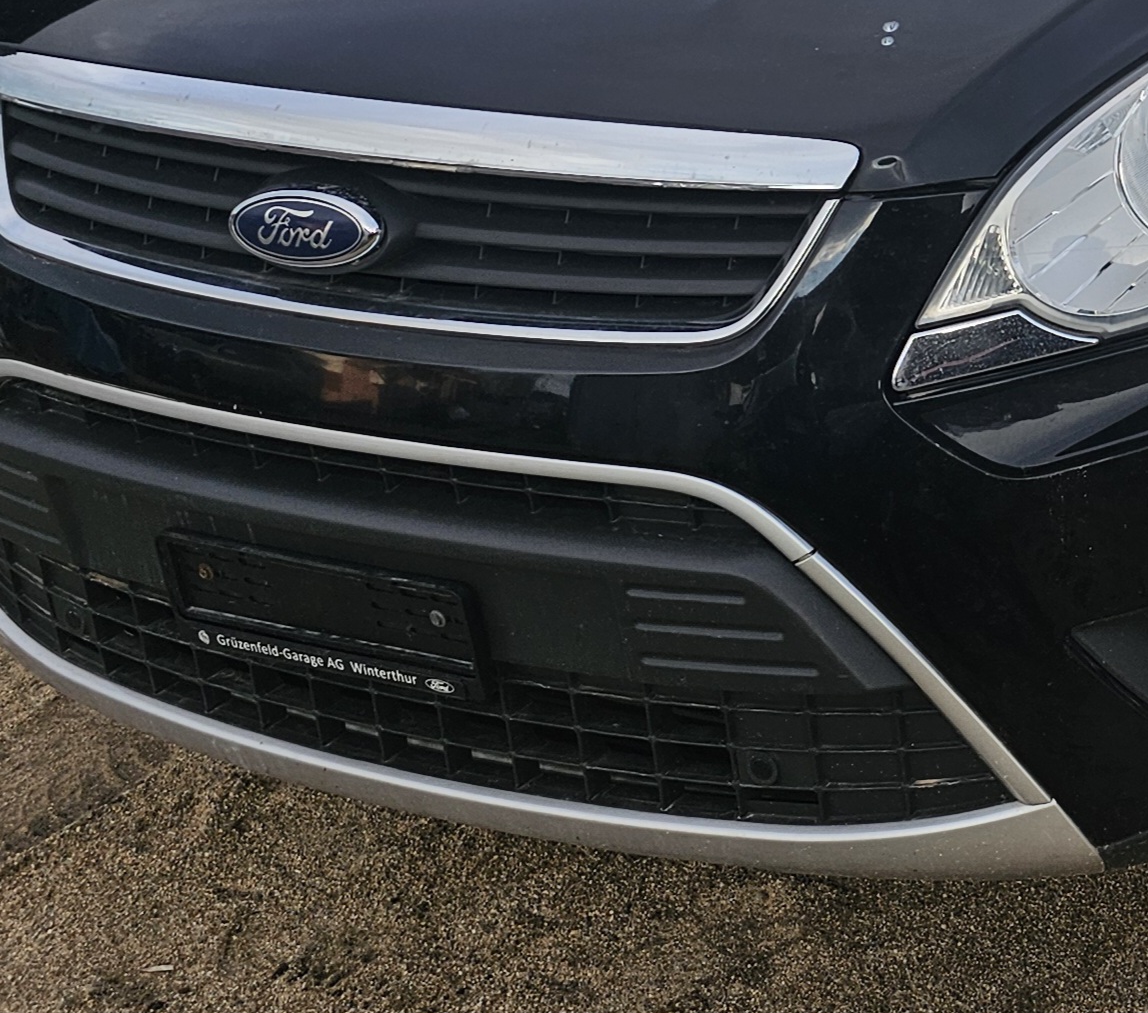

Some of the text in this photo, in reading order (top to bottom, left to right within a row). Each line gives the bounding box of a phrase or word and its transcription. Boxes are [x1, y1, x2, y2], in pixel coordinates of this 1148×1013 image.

[257, 205, 335, 250] Ford
[216, 633, 418, 686] Grüzenfeld-Garage AG Winterthur
